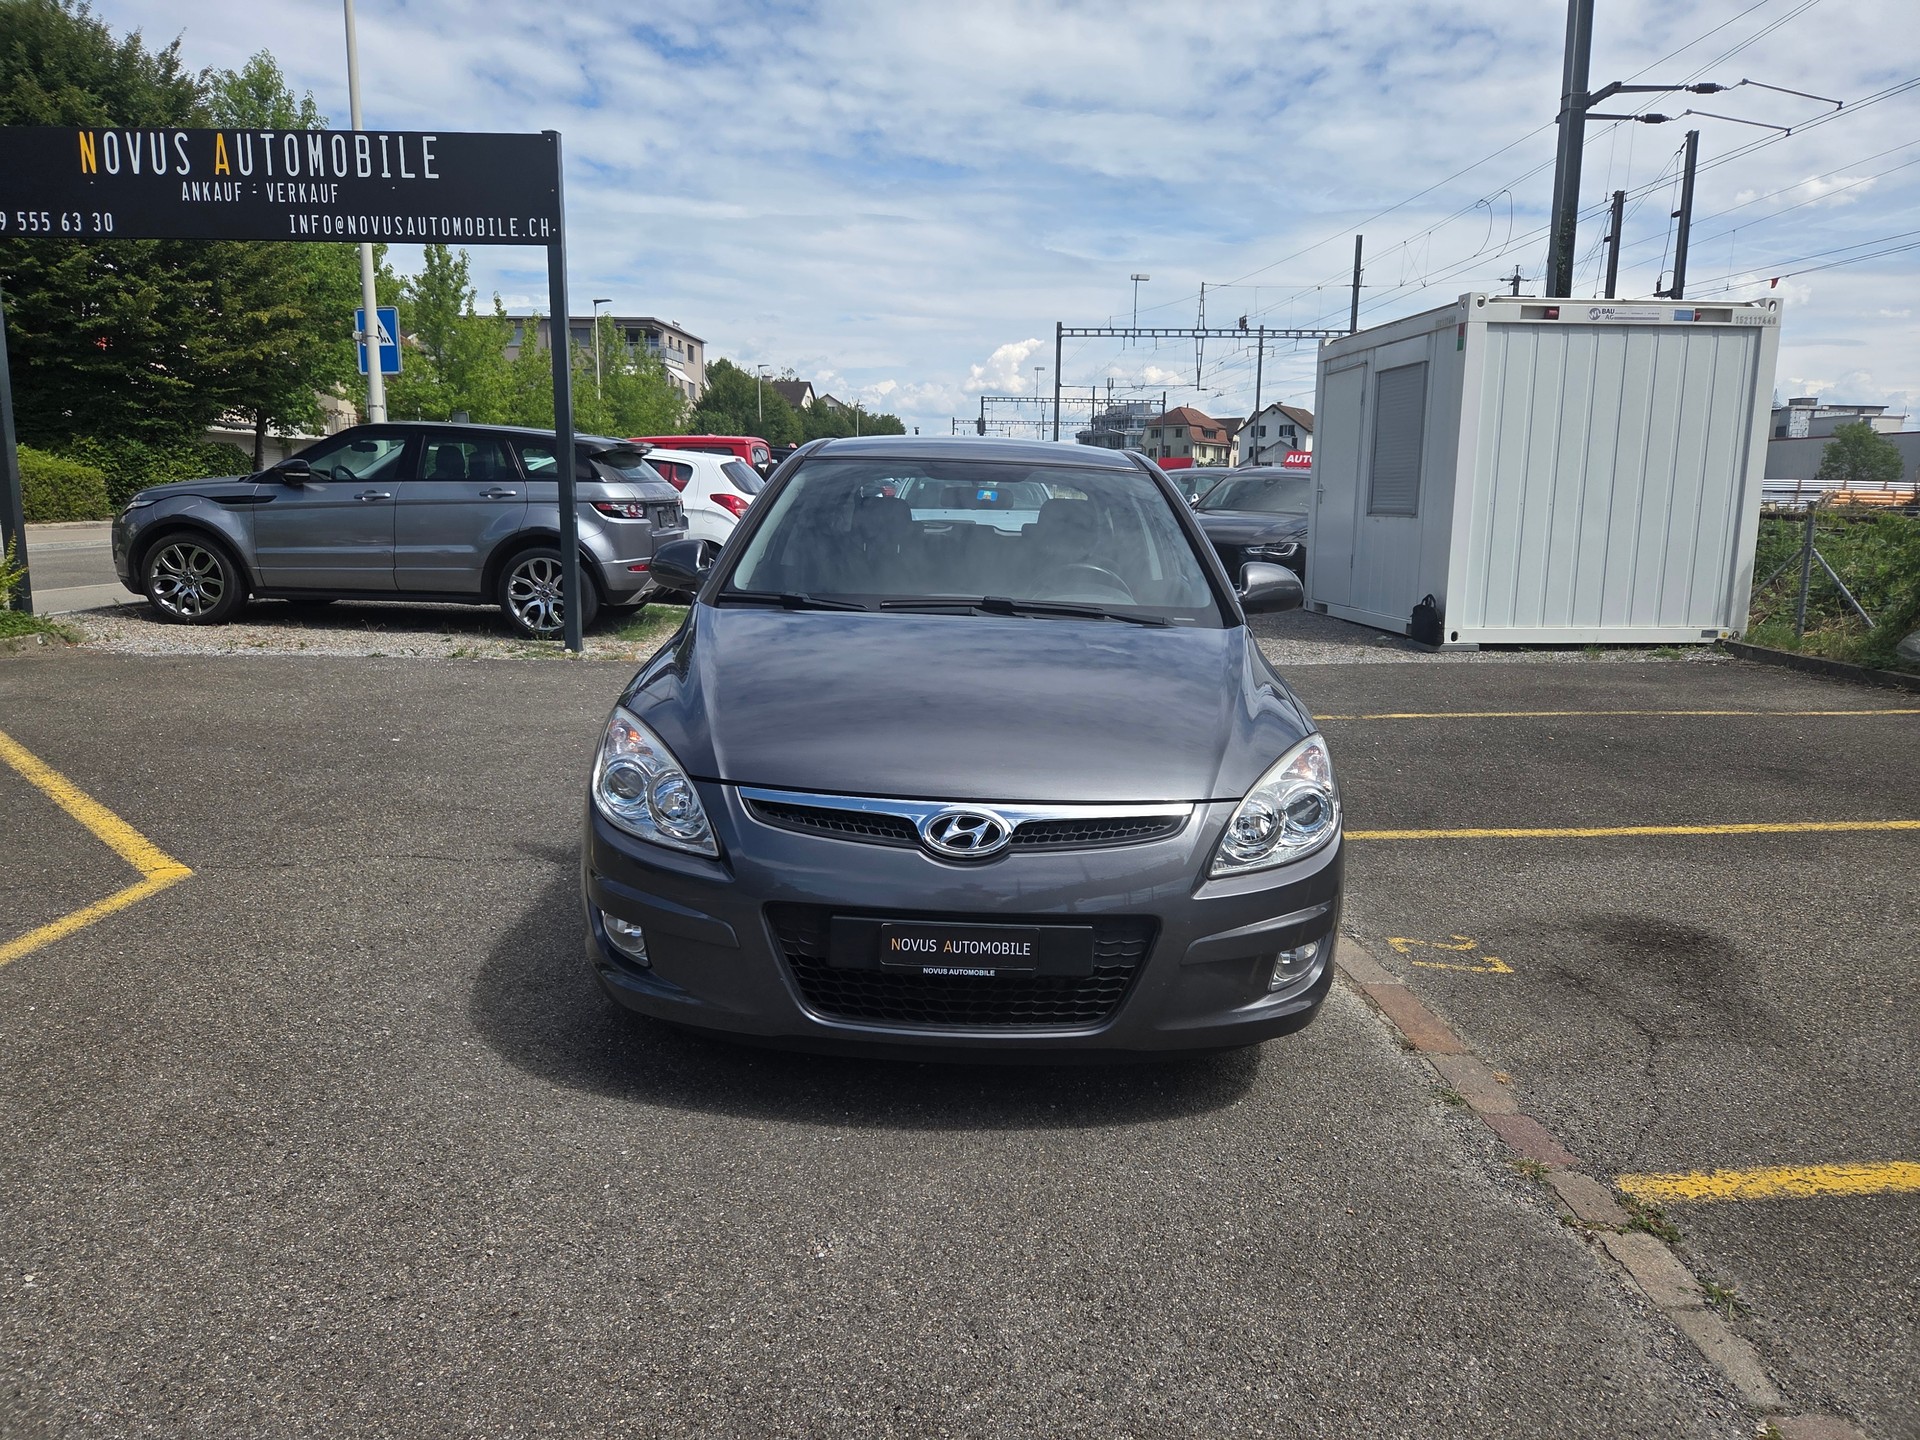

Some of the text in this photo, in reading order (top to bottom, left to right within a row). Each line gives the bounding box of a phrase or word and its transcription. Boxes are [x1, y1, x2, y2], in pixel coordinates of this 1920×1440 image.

[79, 131, 440, 179] NOVUS AUTOMOBILE
[181, 181, 242, 203] ANKAUF
[266, 182, 339, 204] VERKAUF
[17, 211, 51, 231] 555
[61, 211, 82, 232] 63
[92, 212, 113, 232] 30
[289, 214, 550, 238] INFO@NOVUSAUTOMOBILE.CH
[1285, 454, 1312, 463] AUT
[891, 937, 1031, 956] NOVUS AUTOMOBILE
[922, 967, 996, 976] NOVUS AUTOMOBILE
